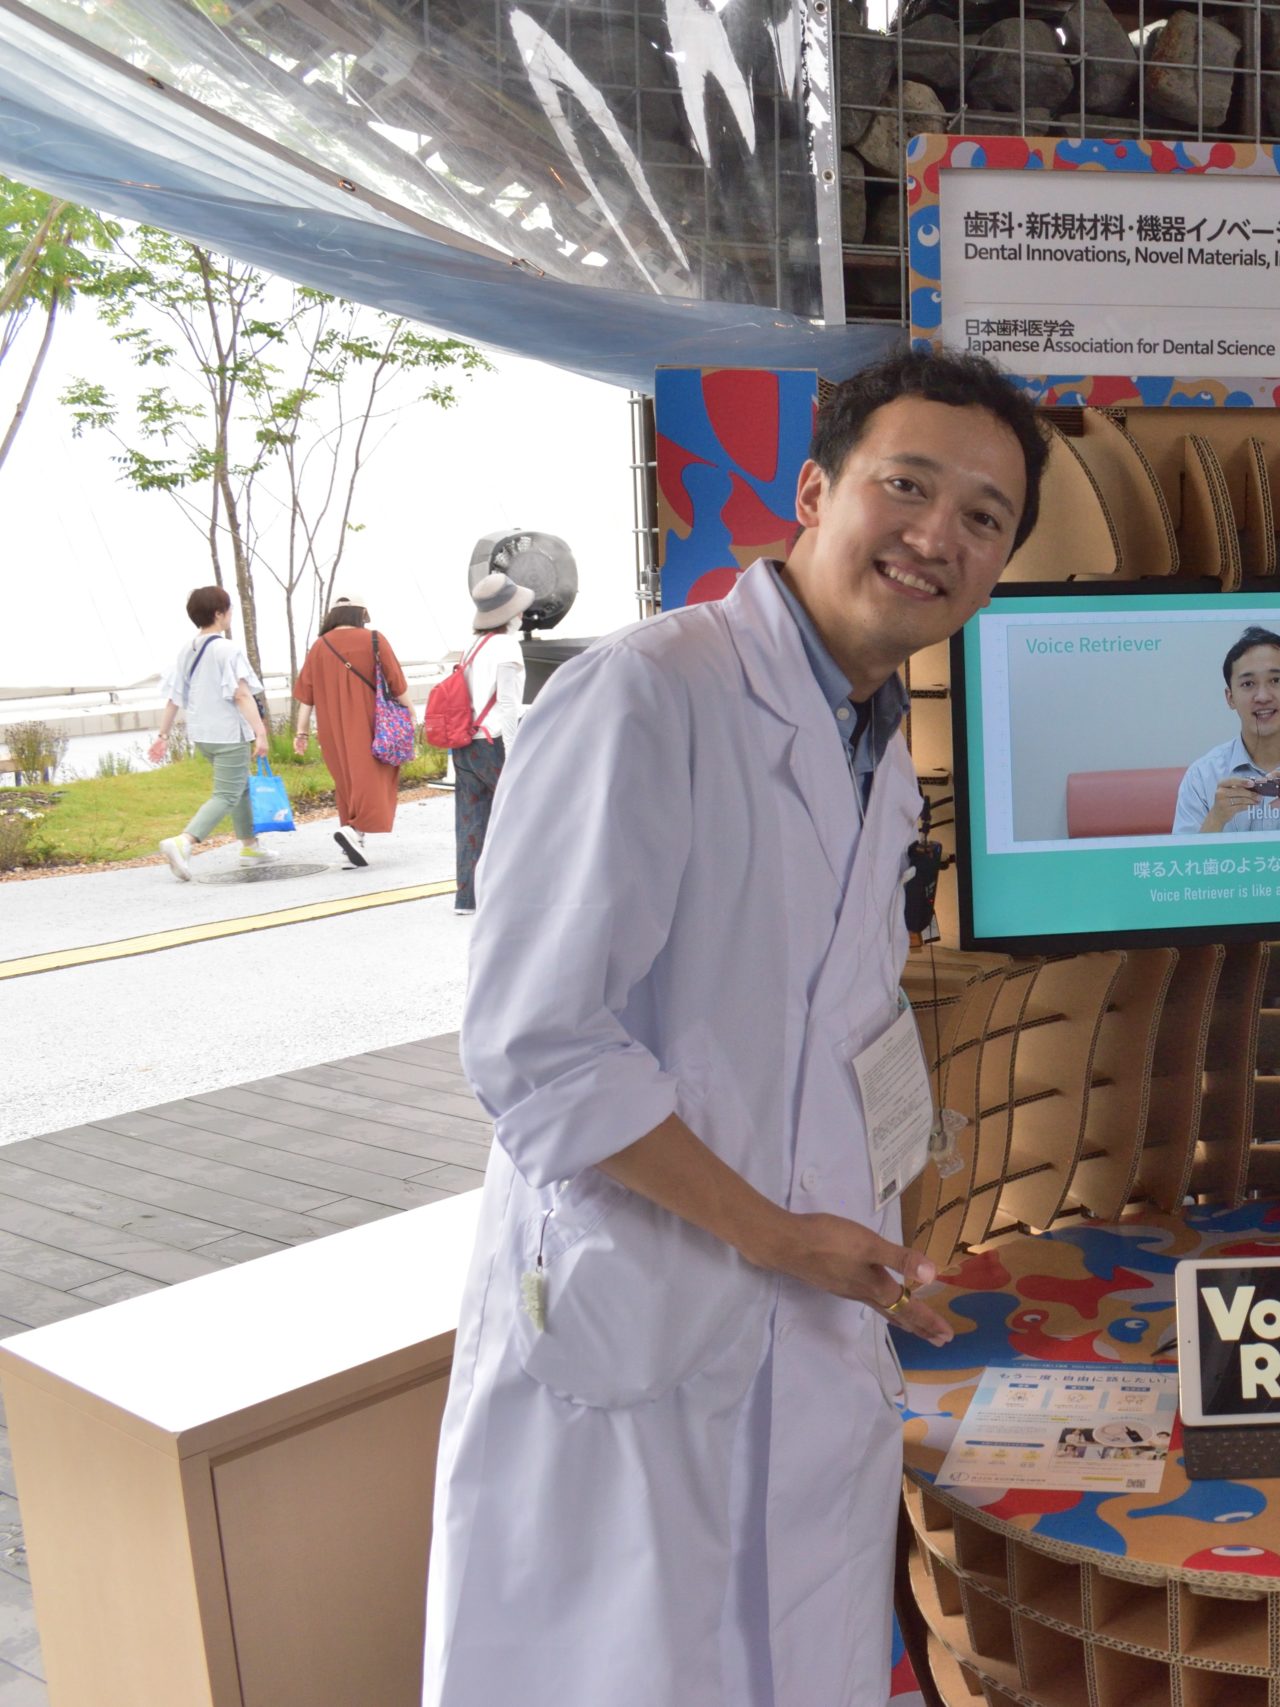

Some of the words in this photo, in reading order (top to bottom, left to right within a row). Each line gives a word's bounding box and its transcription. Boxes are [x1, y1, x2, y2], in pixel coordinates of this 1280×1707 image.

[964, 243, 1022, 261] Dental
[1027, 244, 1131, 266] Innovations,
[1135, 247, 1183, 264] Novel
[1188, 248, 1271, 269] Materials,
[965, 319, 1075, 337] 日本歯科医学会
[964, 338, 1040, 355] Japanese
[1043, 337, 1133, 354] Association
[1137, 338, 1159, 354] for
[1163, 339, 1213, 355] Dental
[1217, 340, 1275, 356] Science
[1026, 637, 1074, 654] Voice
[1079, 635, 1162, 653] Retriever
[1150, 888, 1180, 902] Voice
[1184, 886, 1234, 901] Retriever
[1238, 884, 1248, 898] is
[1252, 883, 1272, 897] like
